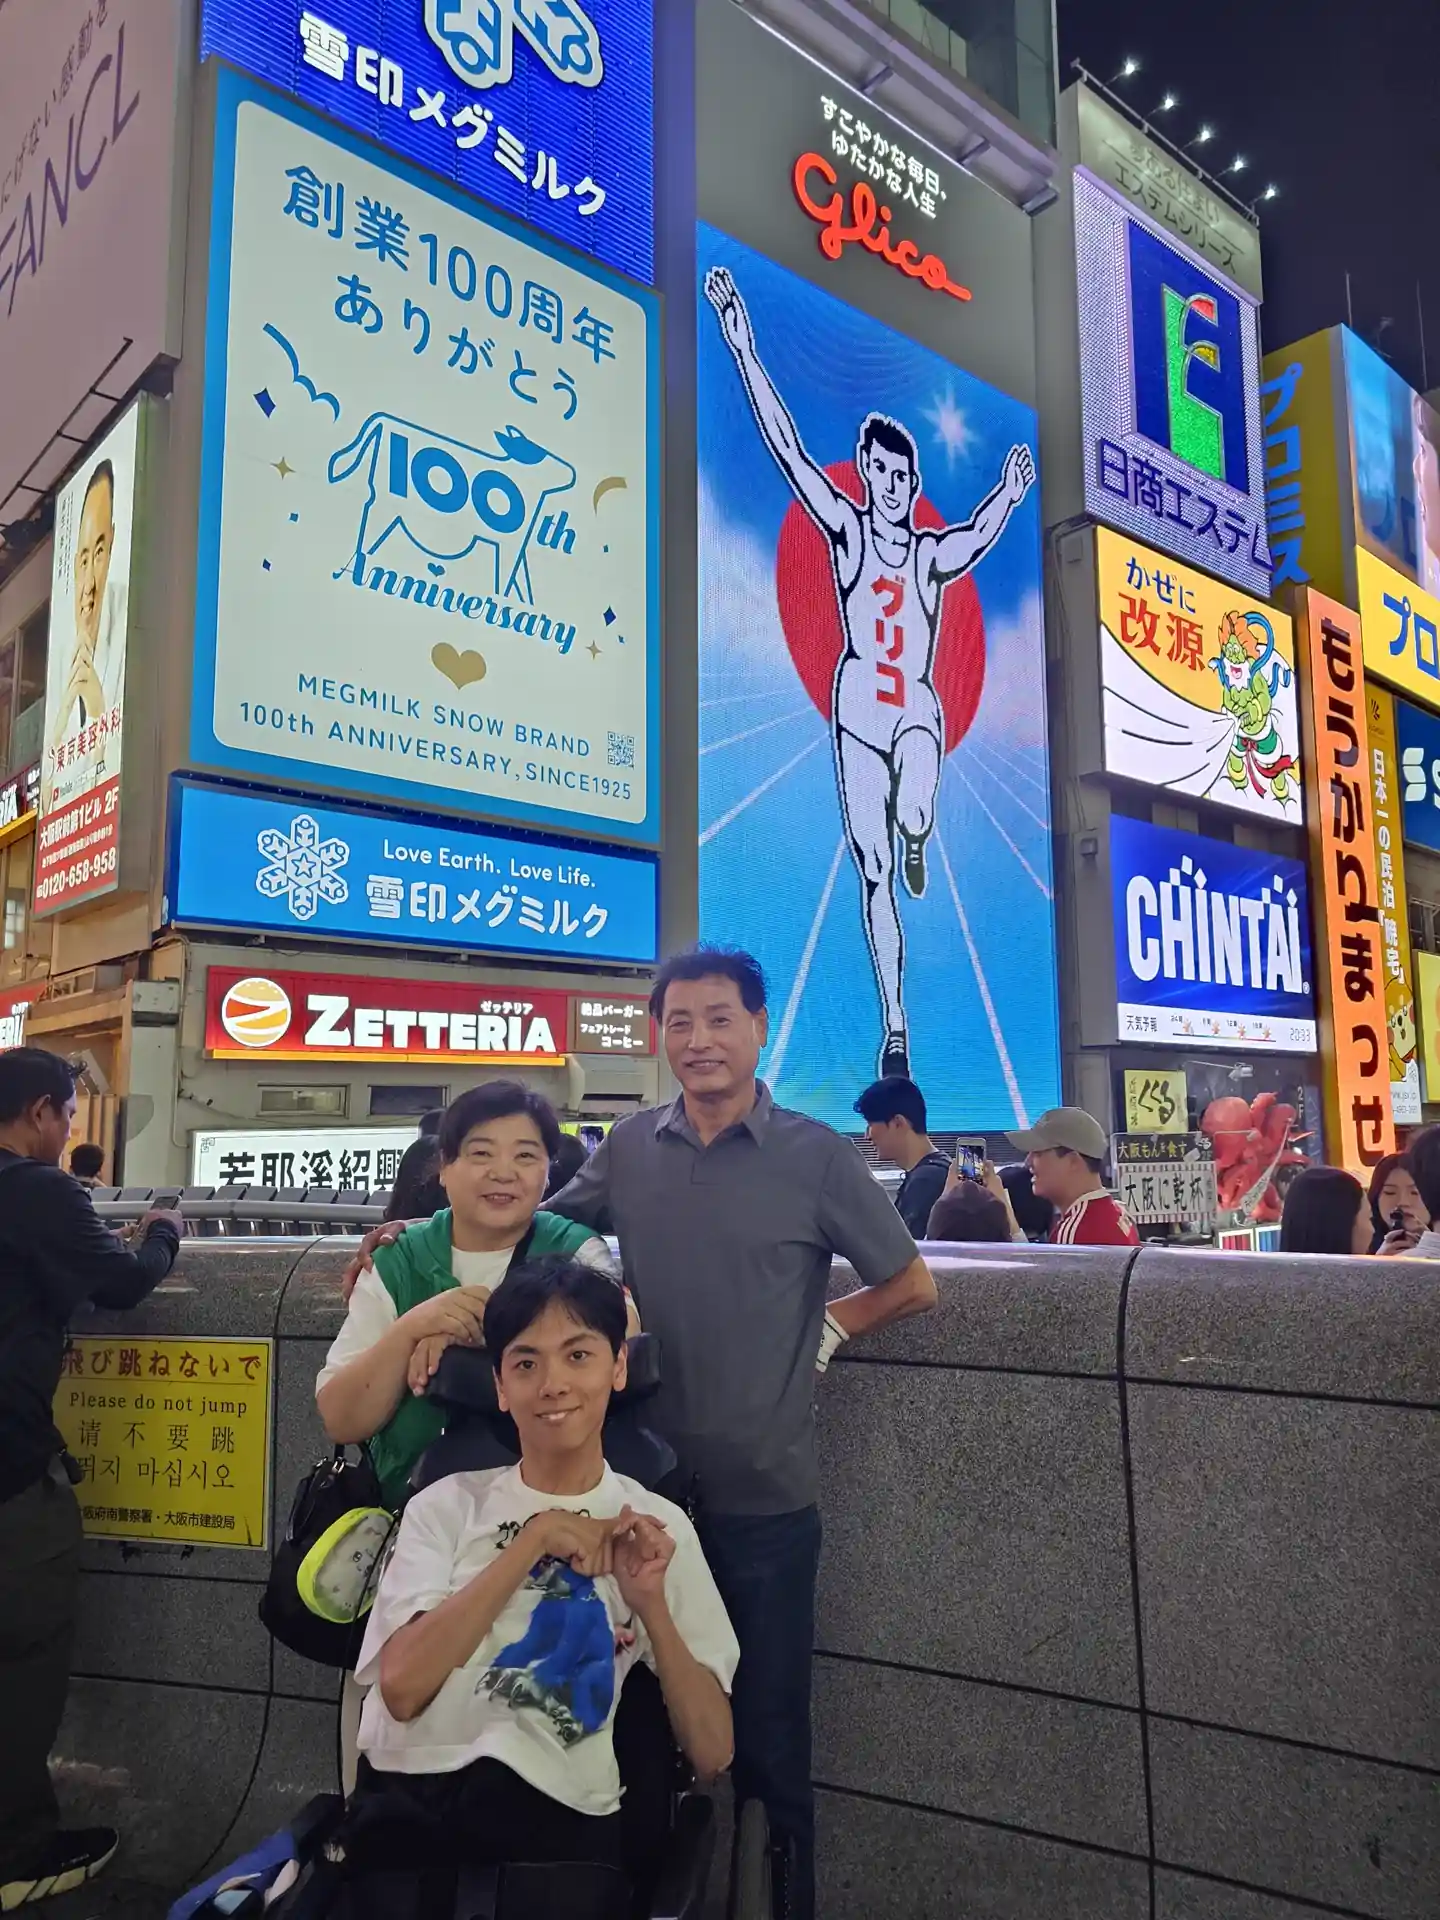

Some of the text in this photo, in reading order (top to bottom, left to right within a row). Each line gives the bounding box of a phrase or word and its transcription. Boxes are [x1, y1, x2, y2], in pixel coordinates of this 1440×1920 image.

[300, 11, 606, 216] 雪印メグミルク
[831, 130, 936, 219] ゆたかな人生
[283, 164, 617, 364] 創業100周年
[792, 152, 972, 301] Glico
[333, 273, 579, 421] ありがとう
[1099, 438, 1275, 574] 日商エステム
[1260, 361, 1313, 585] プロミス
[331, 549, 577, 655] Anniversary
[1125, 556, 1197, 614] かぜに
[870, 573, 906, 709] グリコ
[1117, 592, 1206, 672] 改源
[1382, 591, 1440, 681] プロ
[239, 701, 314, 735] 100th
[298, 672, 591, 758] MEGMILK SNOW BRAND
[103, 786, 119, 814] 2F
[382, 838, 597, 888] Love Earth. Love Life.
[1320, 617, 1385, 1168] もうかりまっせ
[366, 873, 609, 939] 雪印メグミルク
[1126, 855, 1304, 994] CHINTAI
[304, 993, 557, 1054] ZETTERIA
[479, 1000, 534, 1016] ゼッテリア
[600, 1035, 644, 1049] コーヒー
[1137, 1078, 1176, 1125] くくる
[61, 1347, 262, 1381] 飛び跳ねないで
[69, 1391, 248, 1418] Please do not jump
[137, 1456, 236, 1490] 마십시오
[80, 1504, 236, 1530] 阪府南警察署・大阪市建設局
